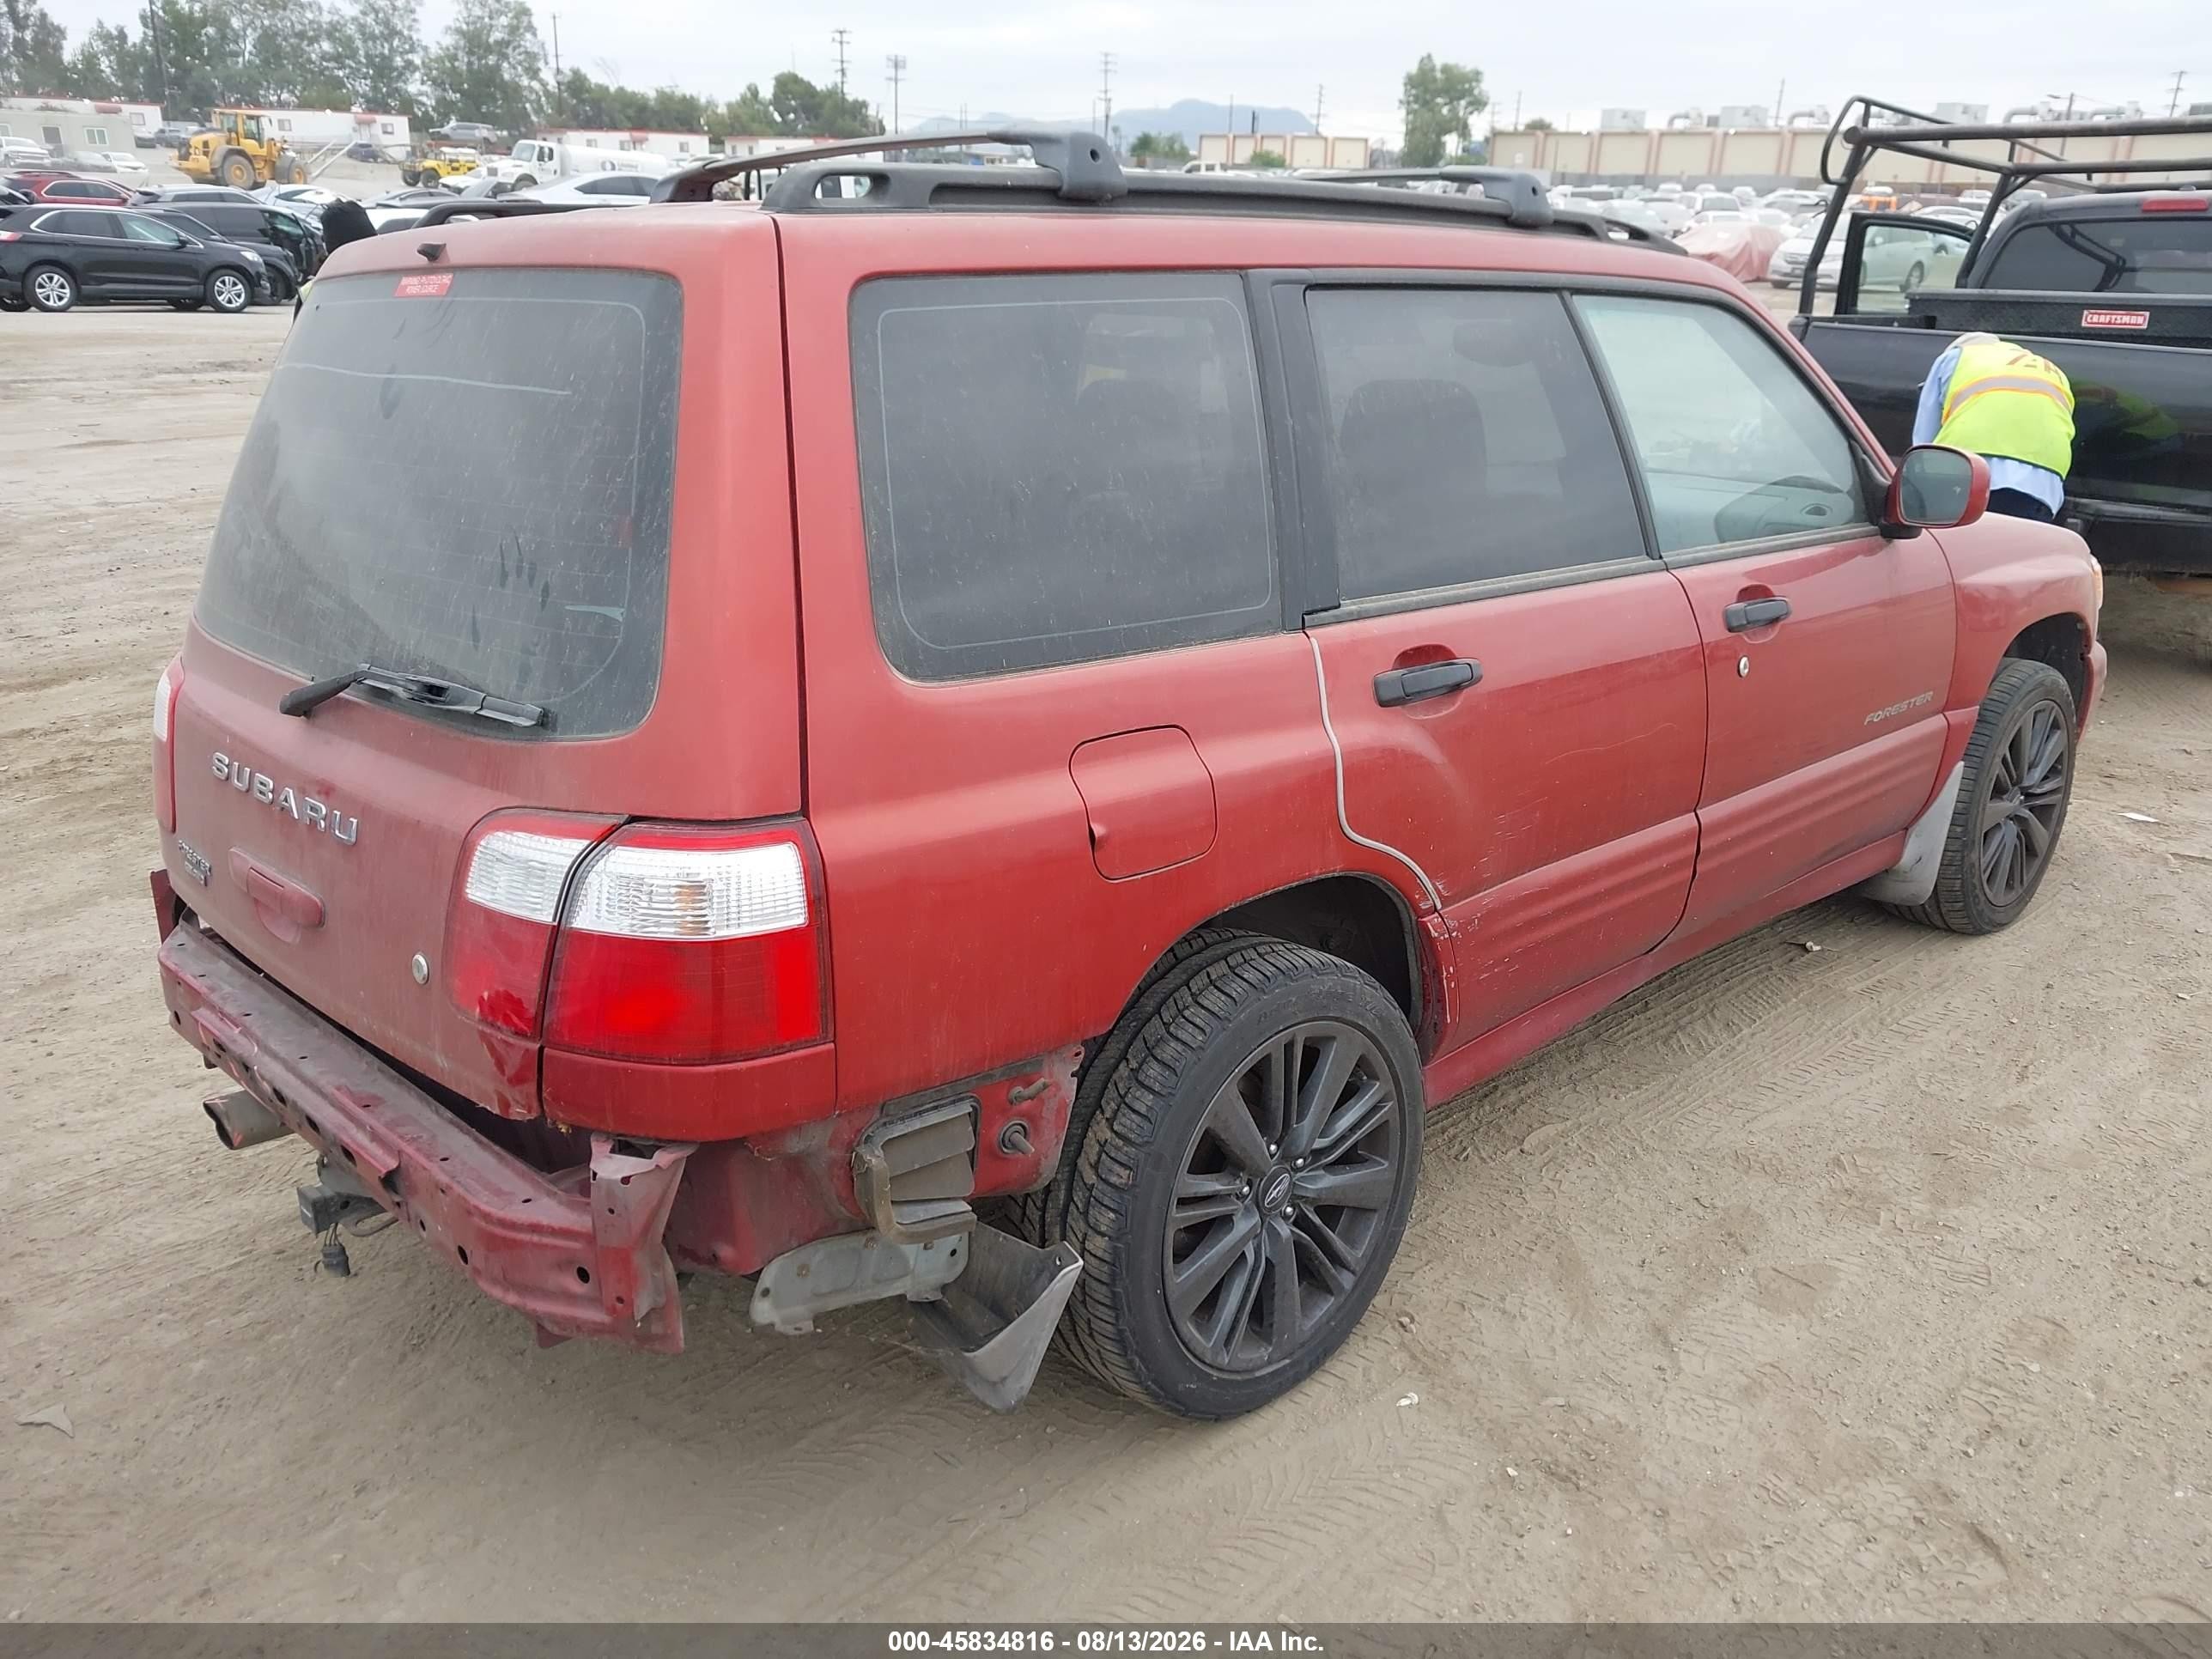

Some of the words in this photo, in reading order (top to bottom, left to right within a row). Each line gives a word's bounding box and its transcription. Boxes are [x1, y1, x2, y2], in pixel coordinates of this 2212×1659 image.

[2086, 313, 2145, 325] CRAFTSMAN
[1863, 690, 1935, 726] FORESTER
[211, 751, 359, 846] SUBARU
